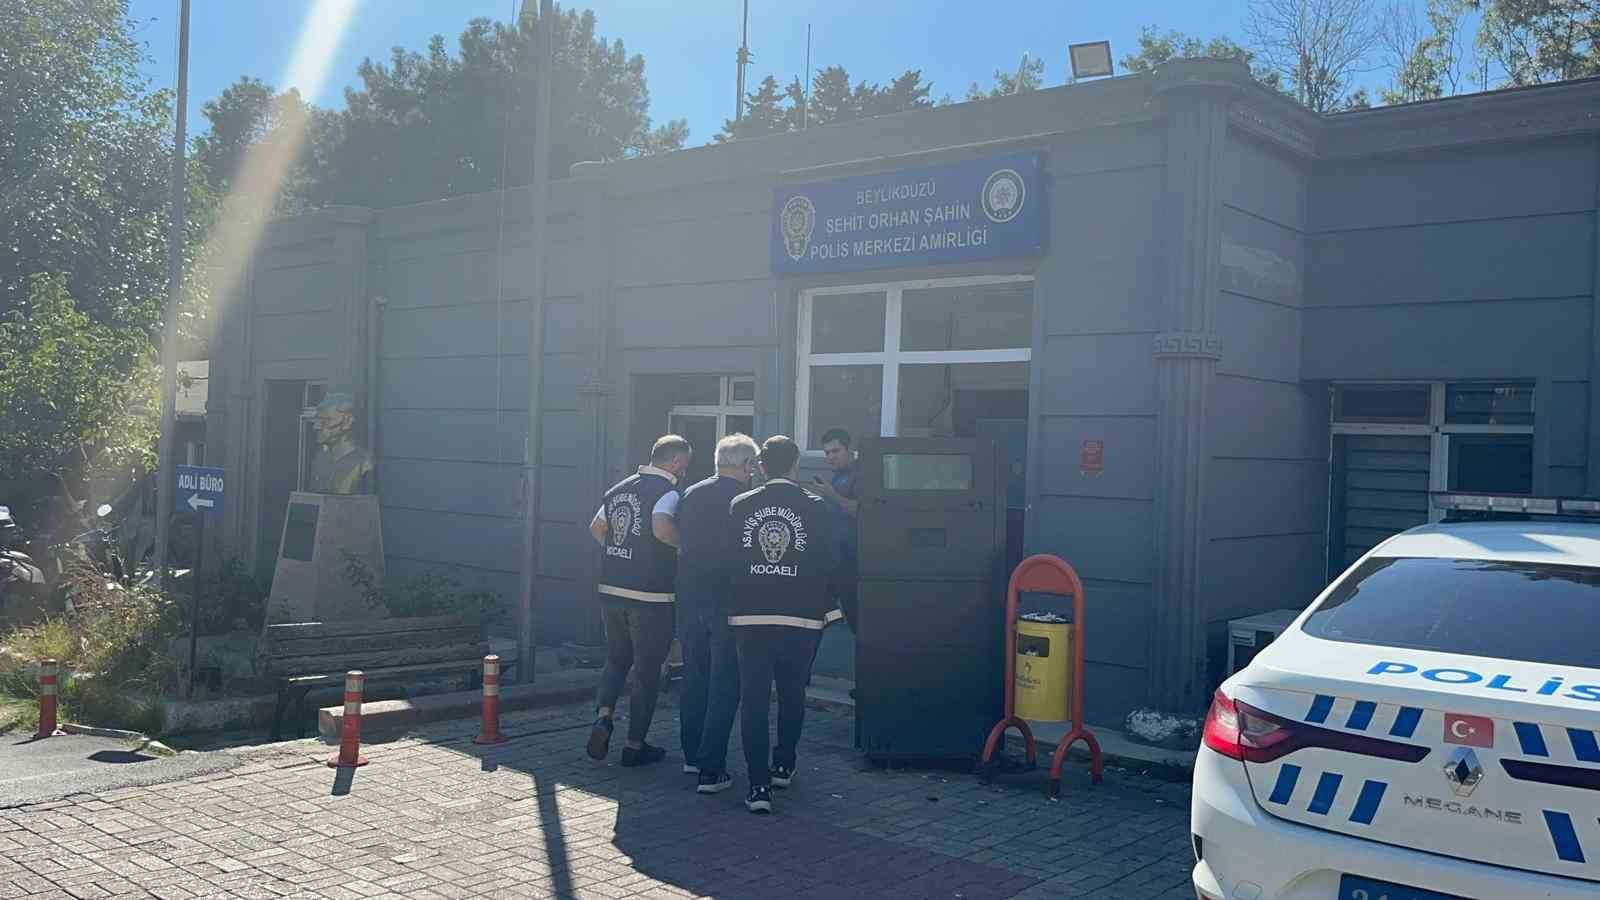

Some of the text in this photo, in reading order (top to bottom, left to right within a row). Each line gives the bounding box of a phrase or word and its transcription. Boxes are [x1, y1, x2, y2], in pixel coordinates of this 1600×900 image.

[868, 208, 919, 230] ORHAN
[923, 201, 971, 227] ŞAHİN
[810, 239, 849, 259] POLİS
[853, 231, 916, 256] MERKEZİ
[200, 473, 224, 492] BÜRO
[754, 506, 777, 521] ŞUBE
[750, 564, 798, 577] KOCAELİ
[1404, 796, 1522, 825] MEGANE
